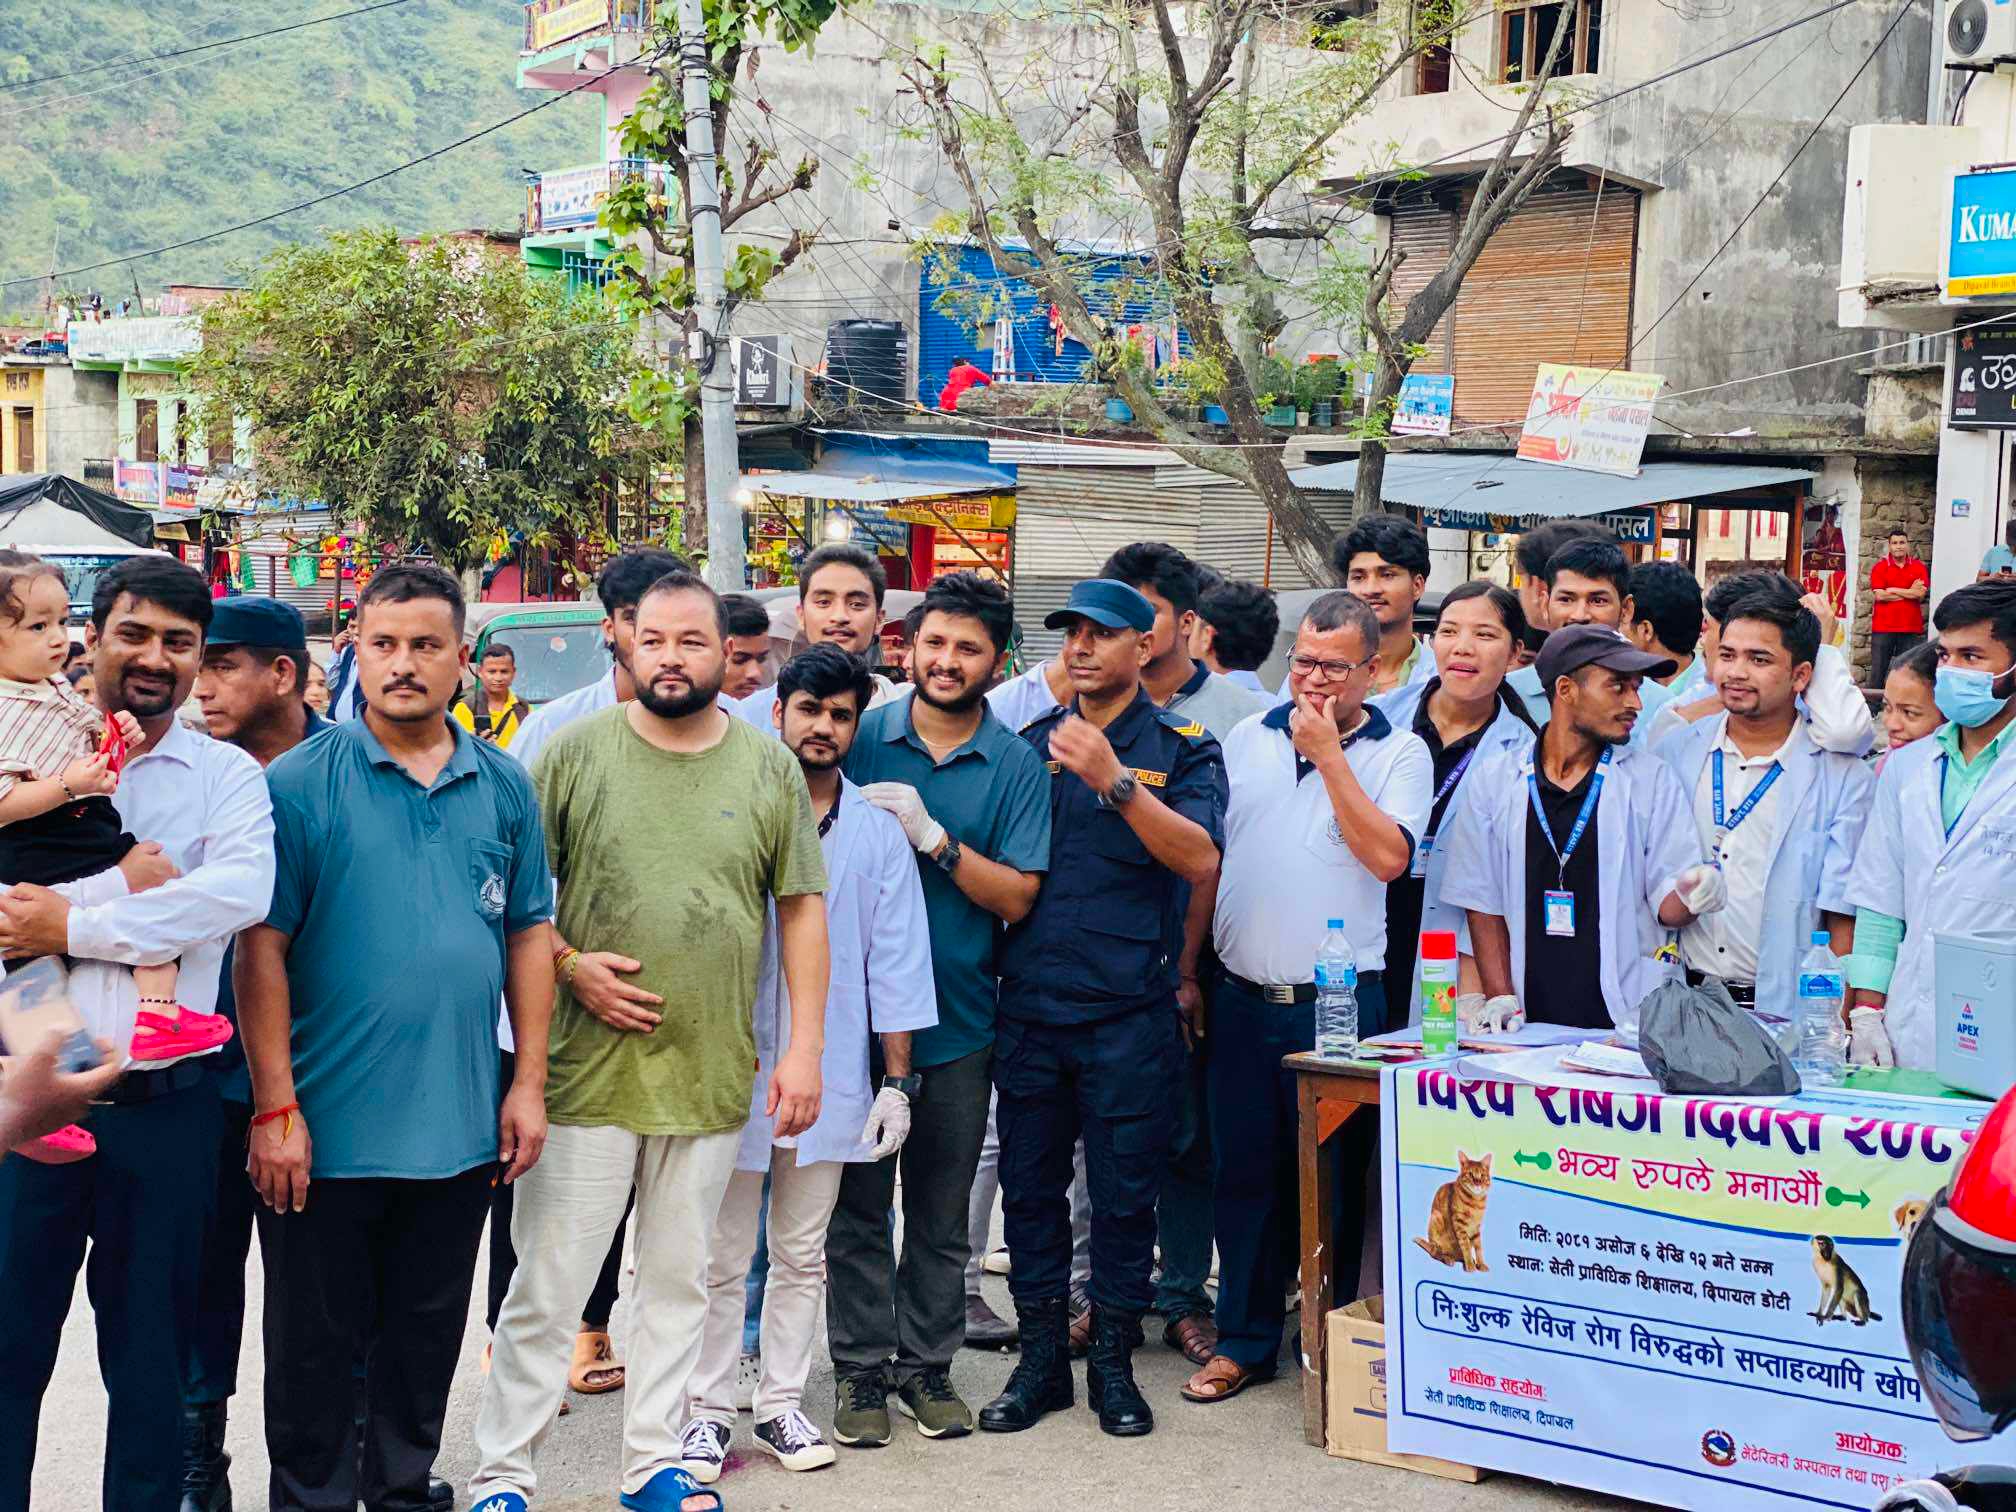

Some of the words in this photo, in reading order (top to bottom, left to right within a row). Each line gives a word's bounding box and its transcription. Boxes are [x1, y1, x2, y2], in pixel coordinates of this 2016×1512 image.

[1136, 770, 1164, 784] POLICE
[1957, 1022, 1979, 1037] APEX
[1557, 1147, 1620, 1181] भव्य
[1632, 1157, 1714, 1192] रुपले
[1556, 1230, 1590, 1249] २०८१
[1595, 1235, 1635, 1257] असोज
[1640, 1242, 1651, 1261] ६
[1656, 1240, 1684, 1263] देखि
[1689, 1252, 1707, 1270] १२
[1712, 1251, 1735, 1272] गते
[1740, 1257, 1774, 1277] सम्म
[1549, 1256, 1575, 1278] सेती
[1578, 1262, 1632, 1287] प्राविधिक
[1635, 1270, 1698, 1299] शिक्षालय,
[1703, 1280, 1756, 1306] दिपायल
[1760, 1288, 1792, 1312] डोटी
[1521, 1304, 1577, 1342] रेविज
[1584, 1316, 1622, 1350] रोग
[1630, 1322, 1725, 1368] विरुद्धको
[1734, 1348, 1865, 1392] सप्ताहव्यापि
[1449, 1365, 1496, 1389] प्राविधिक
[1424, 1387, 1444, 1405] सेती
[1446, 1394, 1487, 1413] प्राविधिक
[1536, 1409, 1575, 1431] दिपायल
[1793, 1457, 1842, 1480] अस्पताल
[1846, 1467, 1868, 1485] तथा
